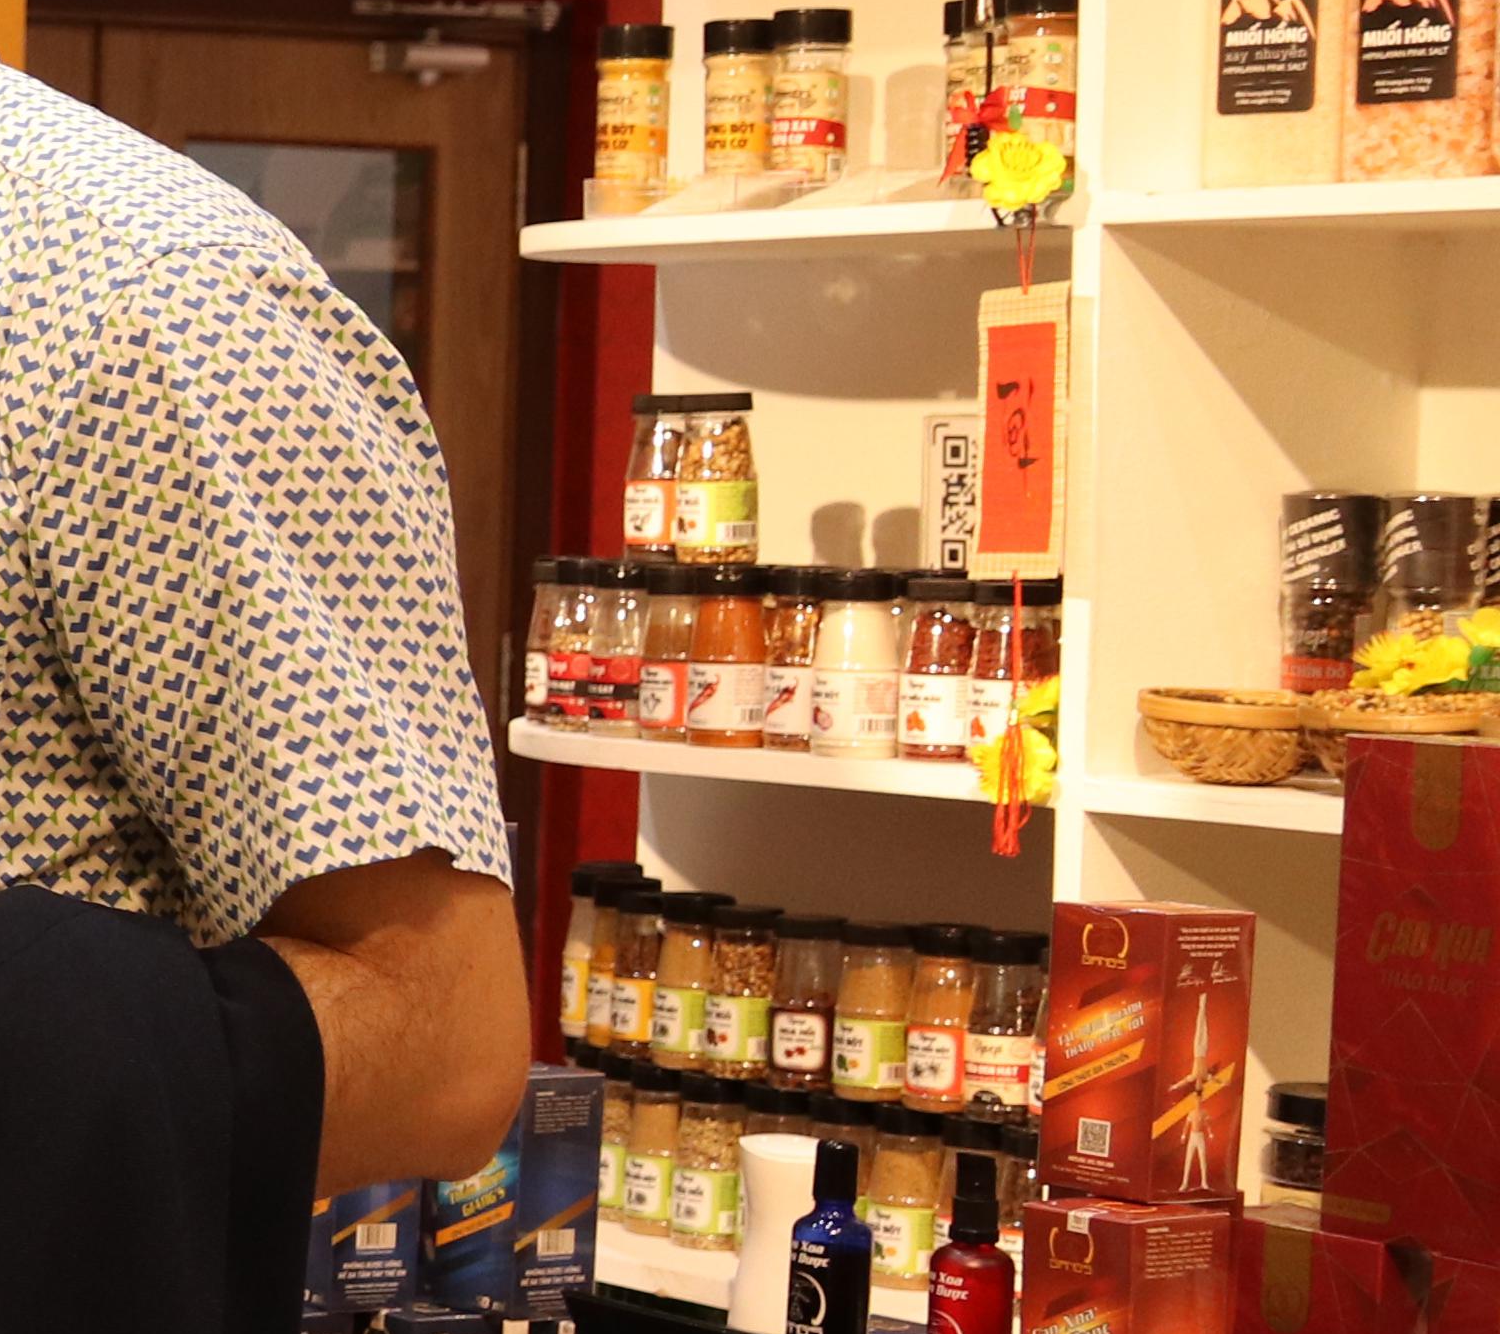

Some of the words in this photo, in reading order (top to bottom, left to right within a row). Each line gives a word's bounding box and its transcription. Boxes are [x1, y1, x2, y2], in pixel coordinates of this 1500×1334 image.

[1225, 22, 1263, 47] MUỐI
[1264, 20, 1308, 45] HỒNG
[1362, 20, 1401, 48] MUỐI
[1403, 18, 1452, 44] HỒNG
[1428, 46, 1449, 56] SALT
[1287, 61, 1308, 72] SALT
